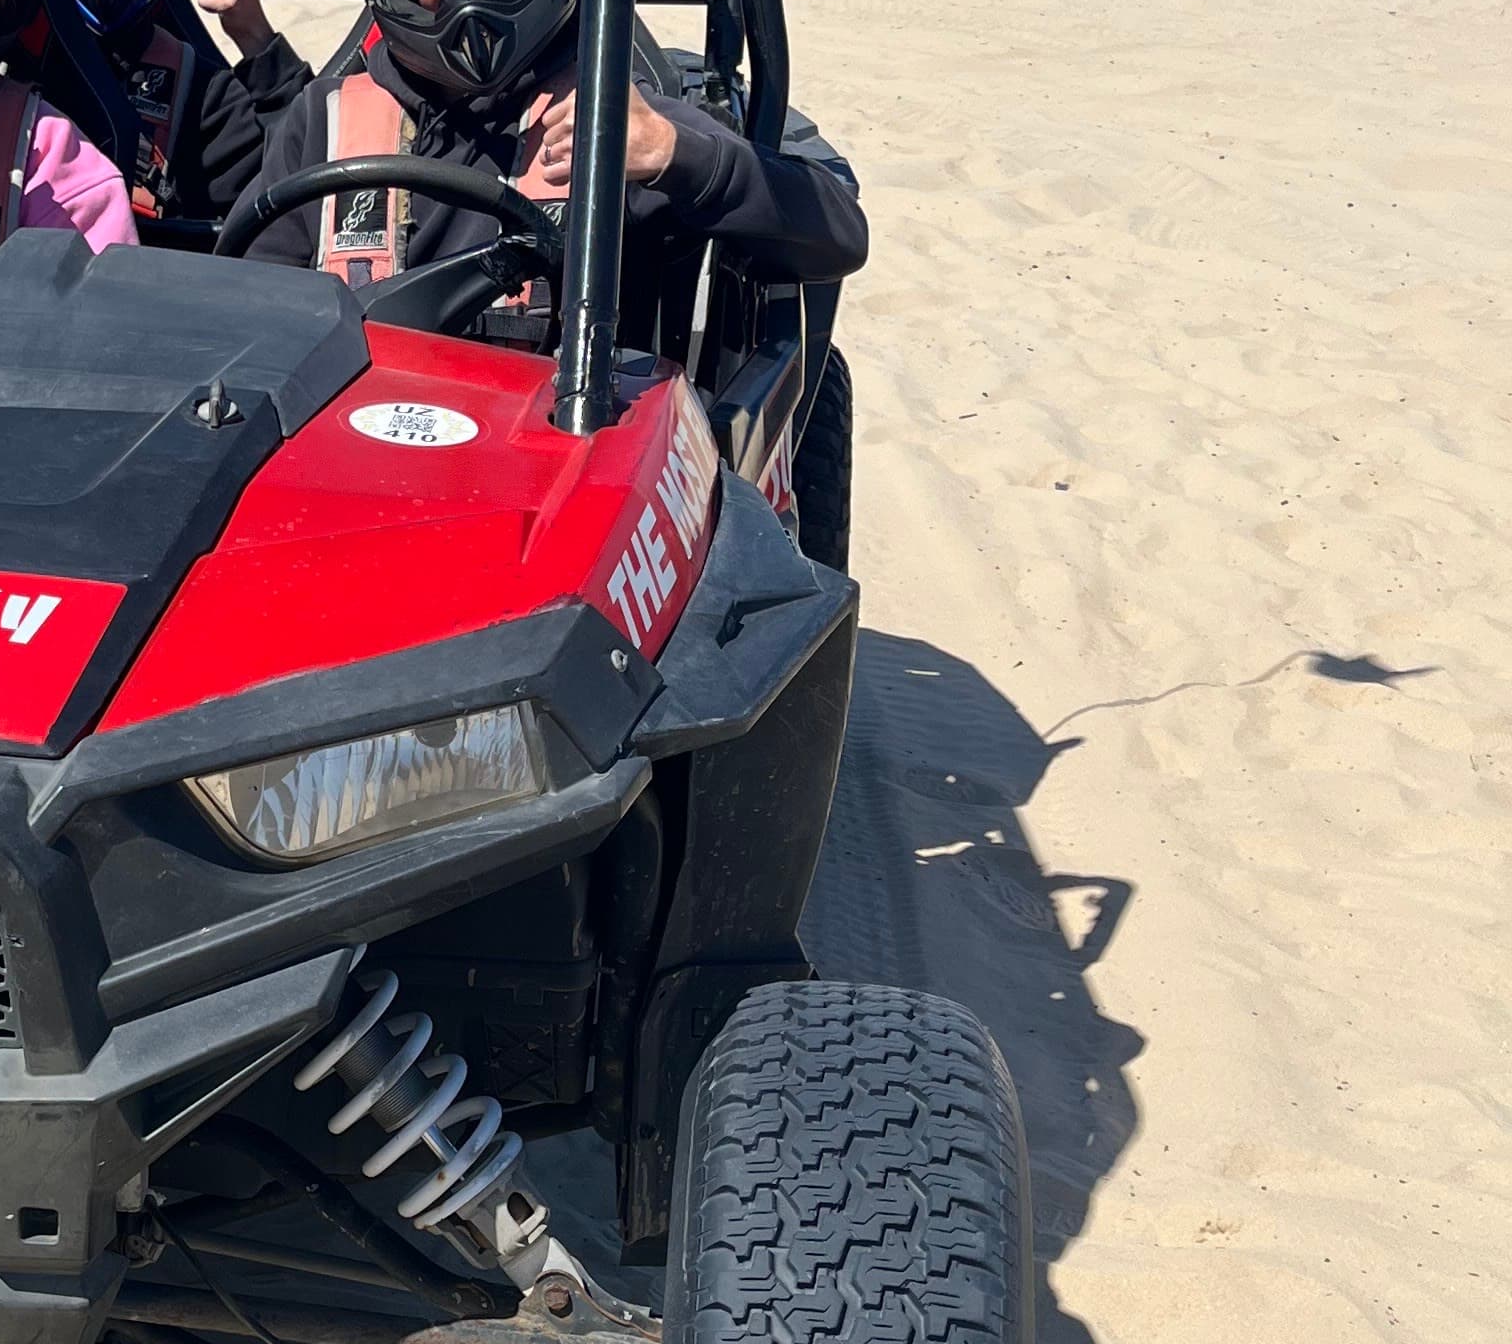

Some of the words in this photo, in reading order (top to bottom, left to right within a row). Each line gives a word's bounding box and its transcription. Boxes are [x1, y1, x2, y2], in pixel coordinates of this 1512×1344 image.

[393, 405, 435, 416] UZ
[383, 430, 438, 443] 410
[607, 503, 678, 650] THE
